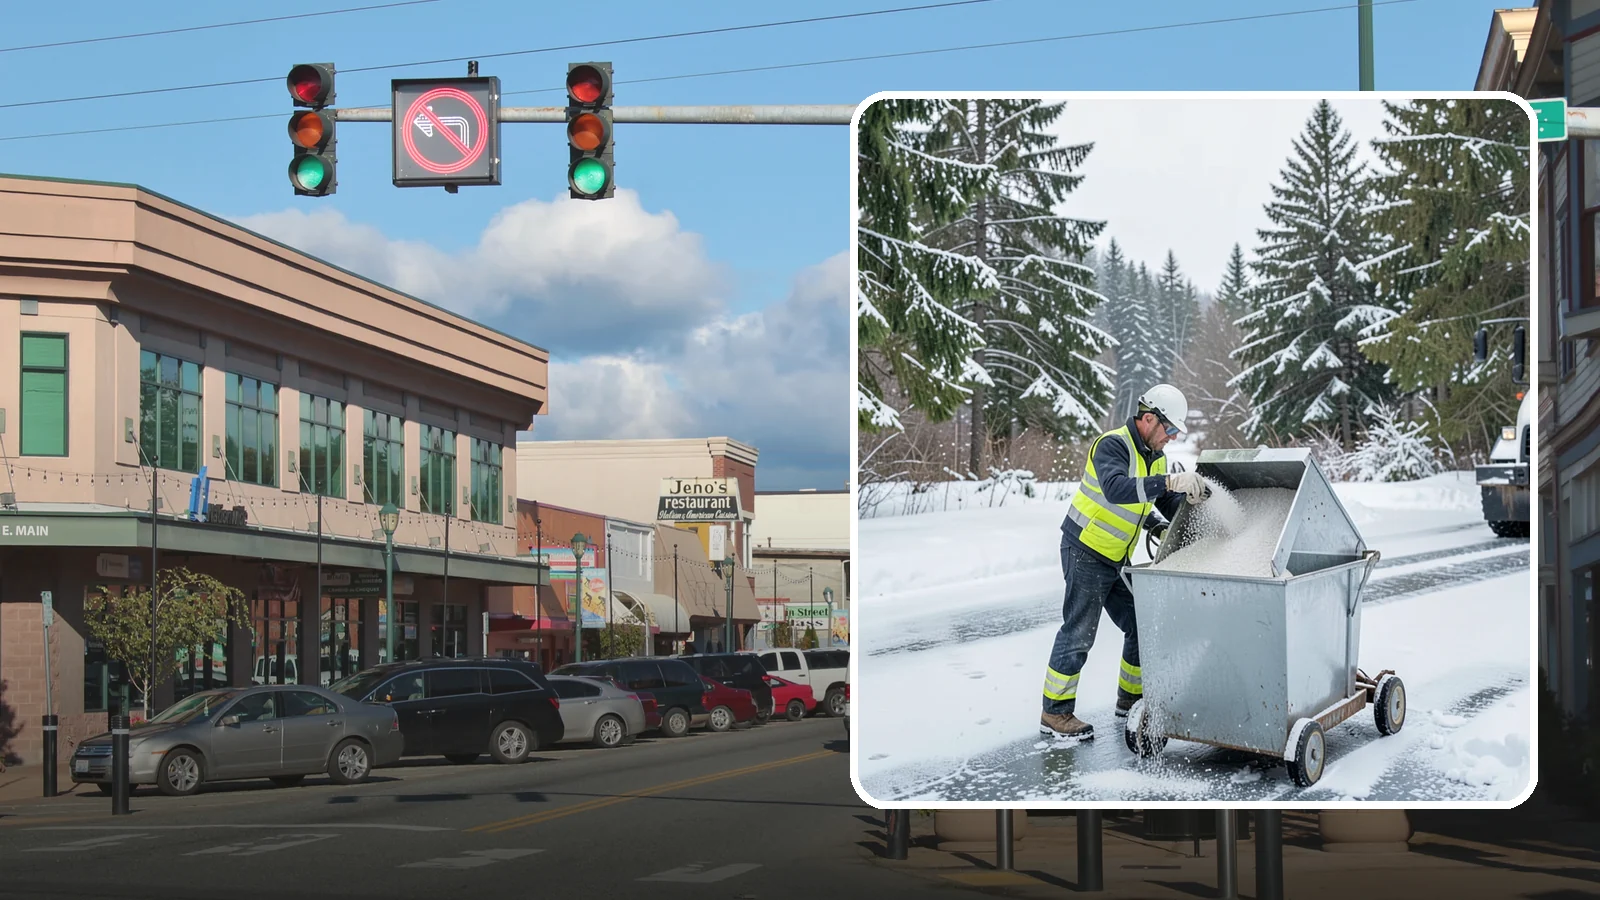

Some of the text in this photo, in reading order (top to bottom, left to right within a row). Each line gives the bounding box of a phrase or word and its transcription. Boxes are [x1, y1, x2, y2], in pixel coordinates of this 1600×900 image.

[670, 480, 728, 495] Jeno's
[665, 496, 731, 509] restaurant
[658, 510, 681, 519] Italian
[686, 510, 714, 519] American
[715, 510, 737, 519] Cuisine
[2, 525, 49, 536] E. MAIN
[797, 607, 829, 617] Street
